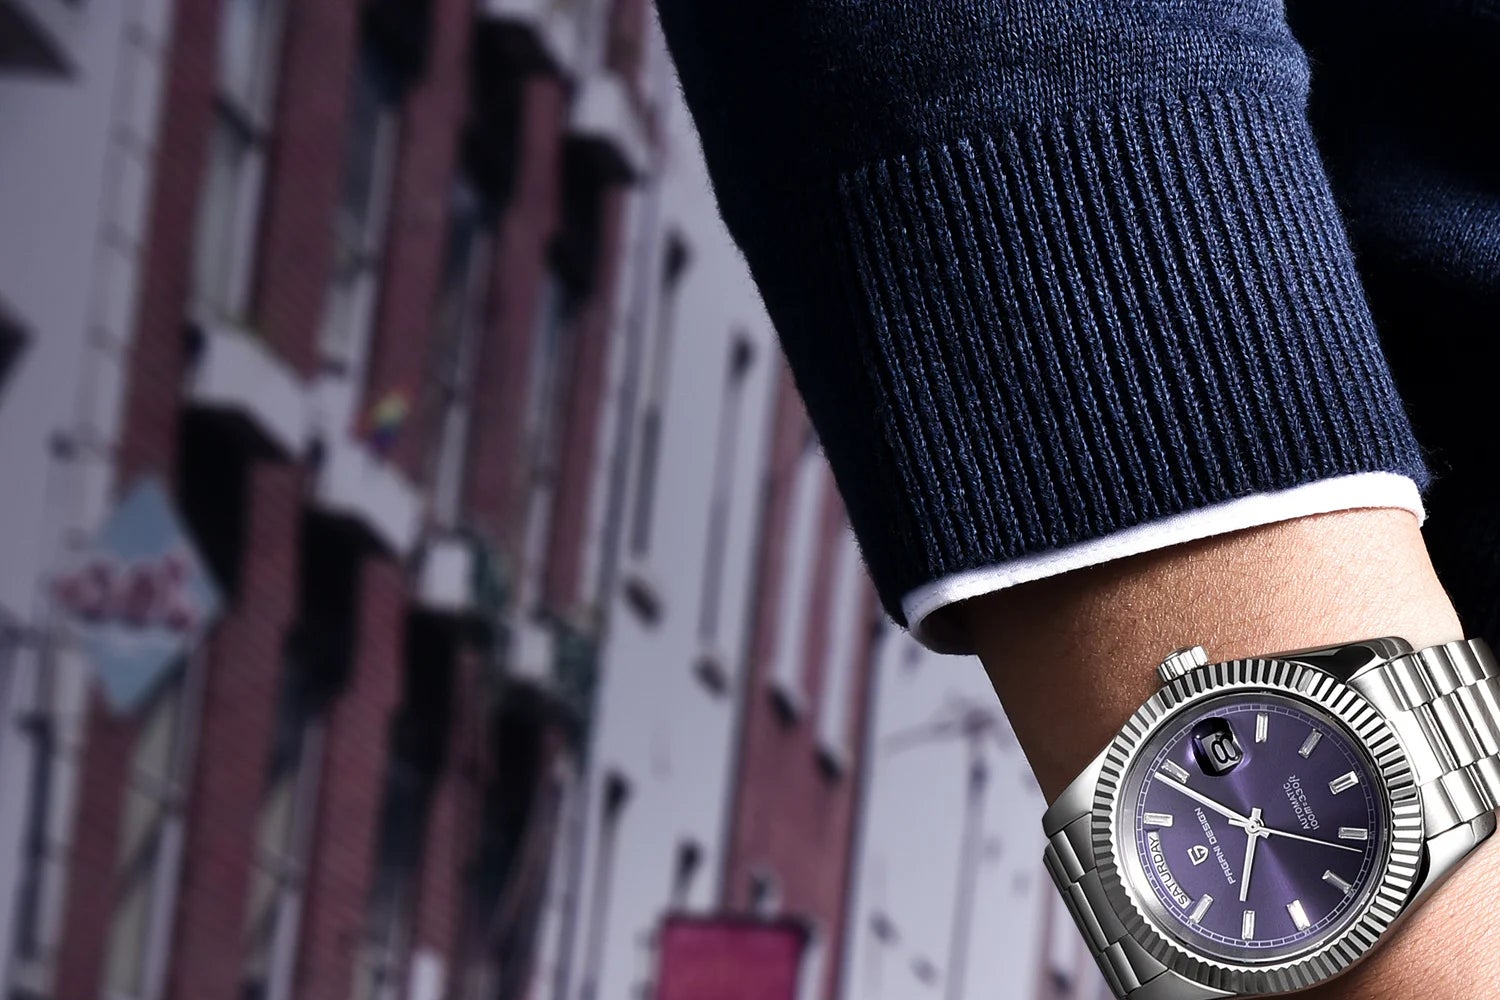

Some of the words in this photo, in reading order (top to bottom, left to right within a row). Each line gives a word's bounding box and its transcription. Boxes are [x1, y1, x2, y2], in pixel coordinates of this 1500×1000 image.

[1194, 807, 1217, 845] DESIGN
[1283, 782, 1310, 830] AUTOMATIC
[1148, 836, 1188, 905] SATURDAY
[1213, 846, 1236, 885] PAGANI
